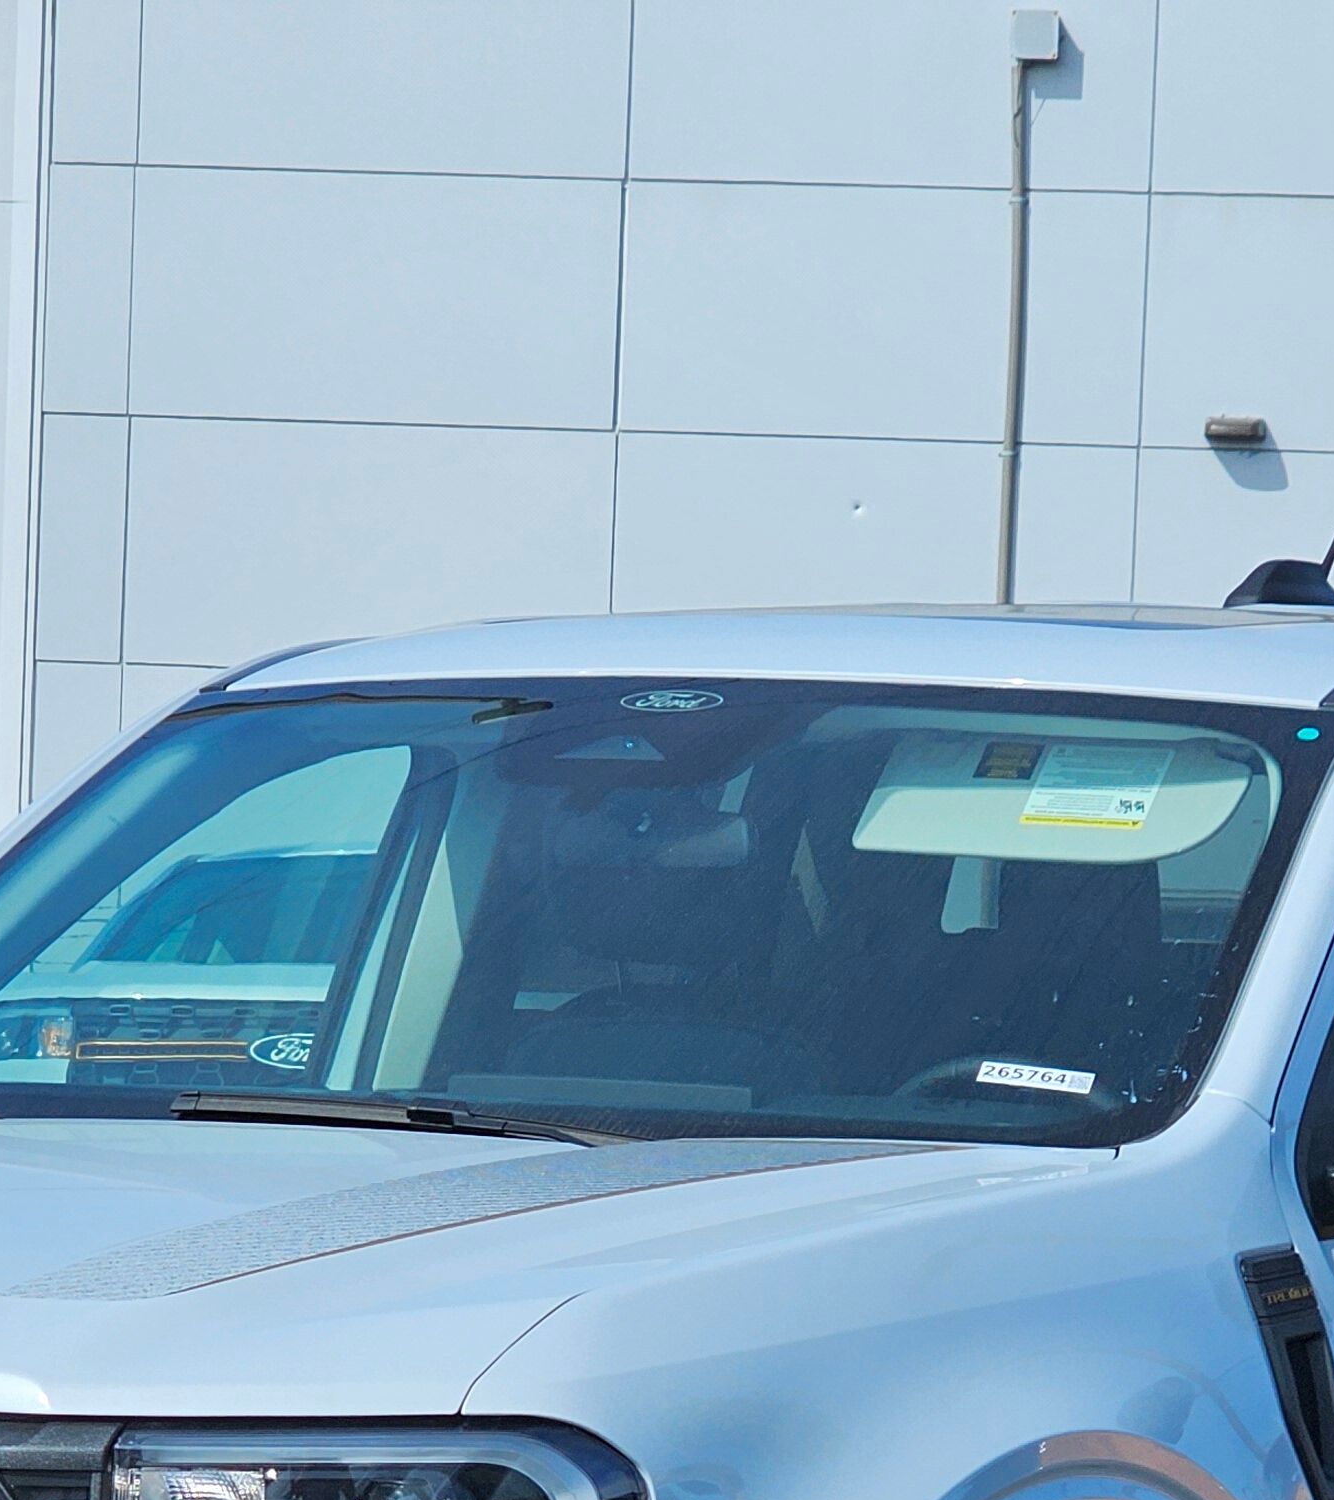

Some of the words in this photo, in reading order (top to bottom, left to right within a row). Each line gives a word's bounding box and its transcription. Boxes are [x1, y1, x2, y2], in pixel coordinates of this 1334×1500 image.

[635, 692, 707, 709] Ford
[270, 1037, 313, 1062] For
[983, 1065, 1067, 1085] 265764
